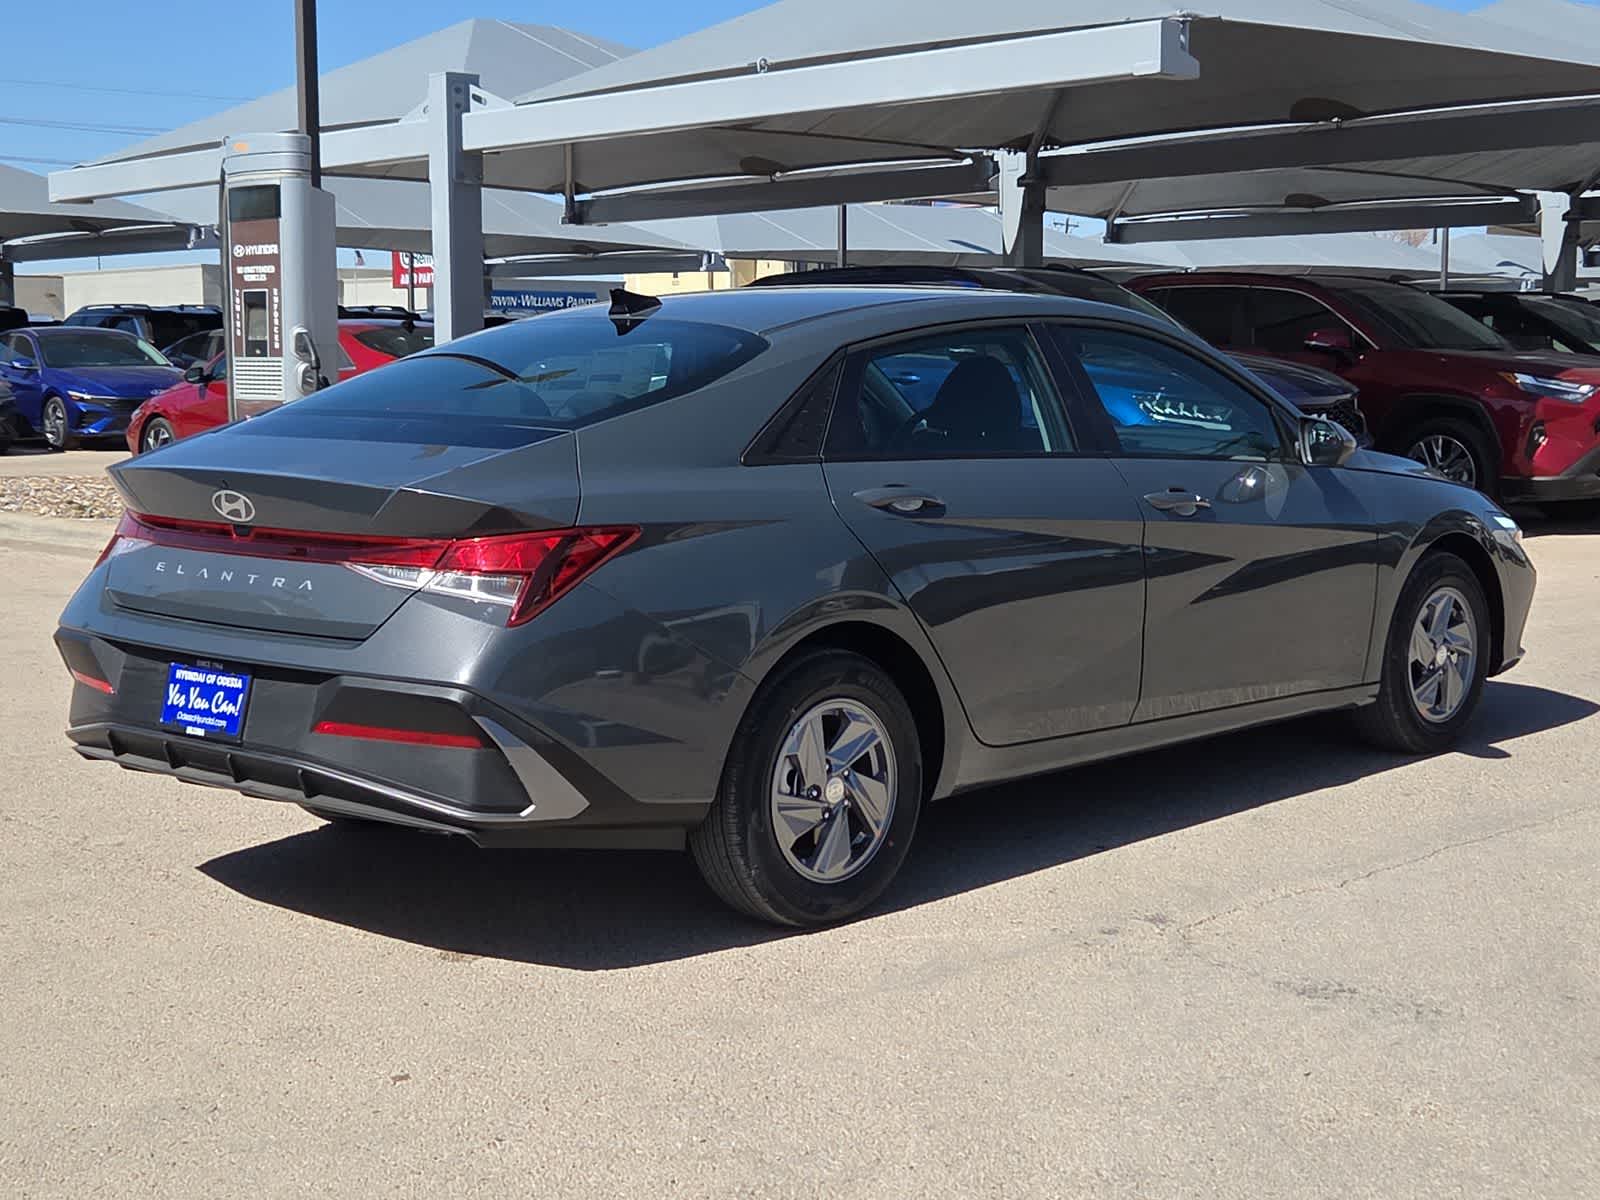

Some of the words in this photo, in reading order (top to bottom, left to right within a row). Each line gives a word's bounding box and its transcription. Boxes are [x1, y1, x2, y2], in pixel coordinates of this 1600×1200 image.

[491, 294, 564, 307] RWIN-WILLIAMS
[155, 561, 313, 591] ELANTRA
[175, 669, 206, 683] HYUNDAI
[206, 673, 217, 685] OF
[167, 683, 186, 707] Yes
[187, 687, 210, 709] You
[211, 691, 244, 717] Can!
